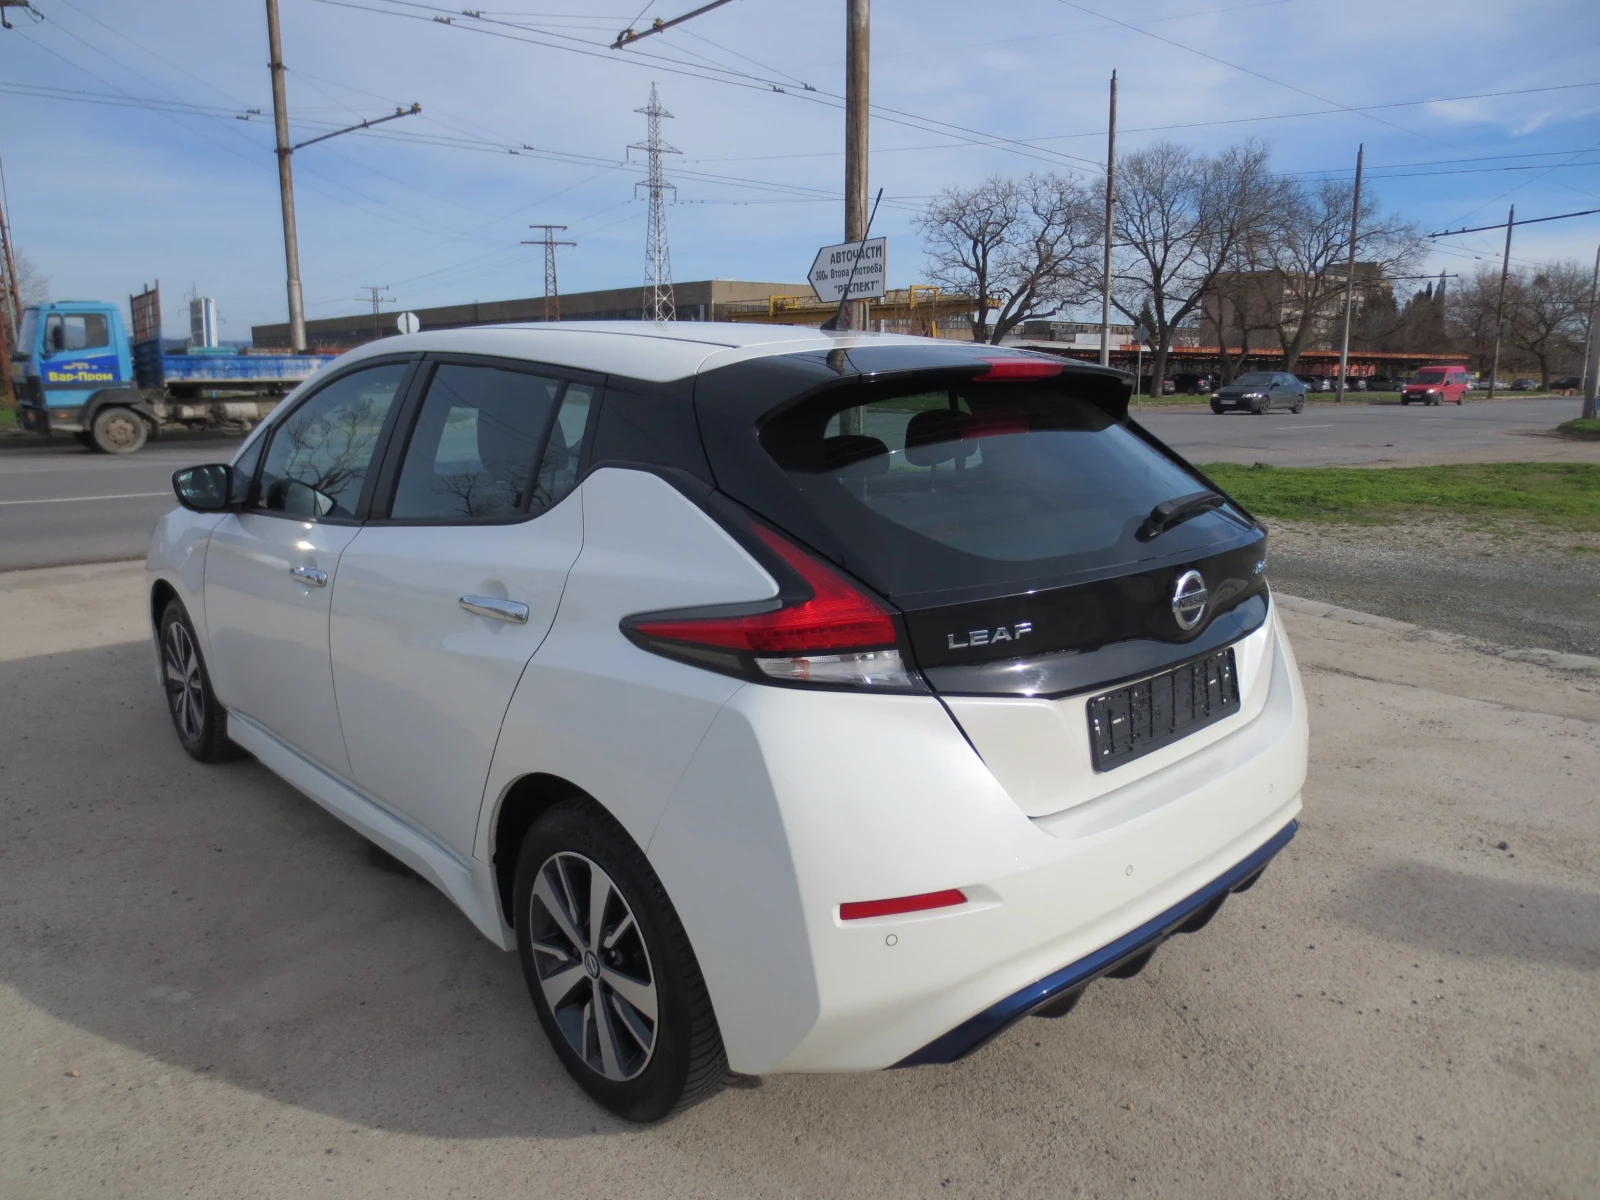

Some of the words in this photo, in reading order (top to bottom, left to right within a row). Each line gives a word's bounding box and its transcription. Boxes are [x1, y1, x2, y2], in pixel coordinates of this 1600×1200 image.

[830, 245, 882, 264] АВТОЧАСТИ
[830, 268, 850, 279] Втора
[1178, 593, 1208, 609] NISSAN
[947, 622, 1032, 650] LEAF
